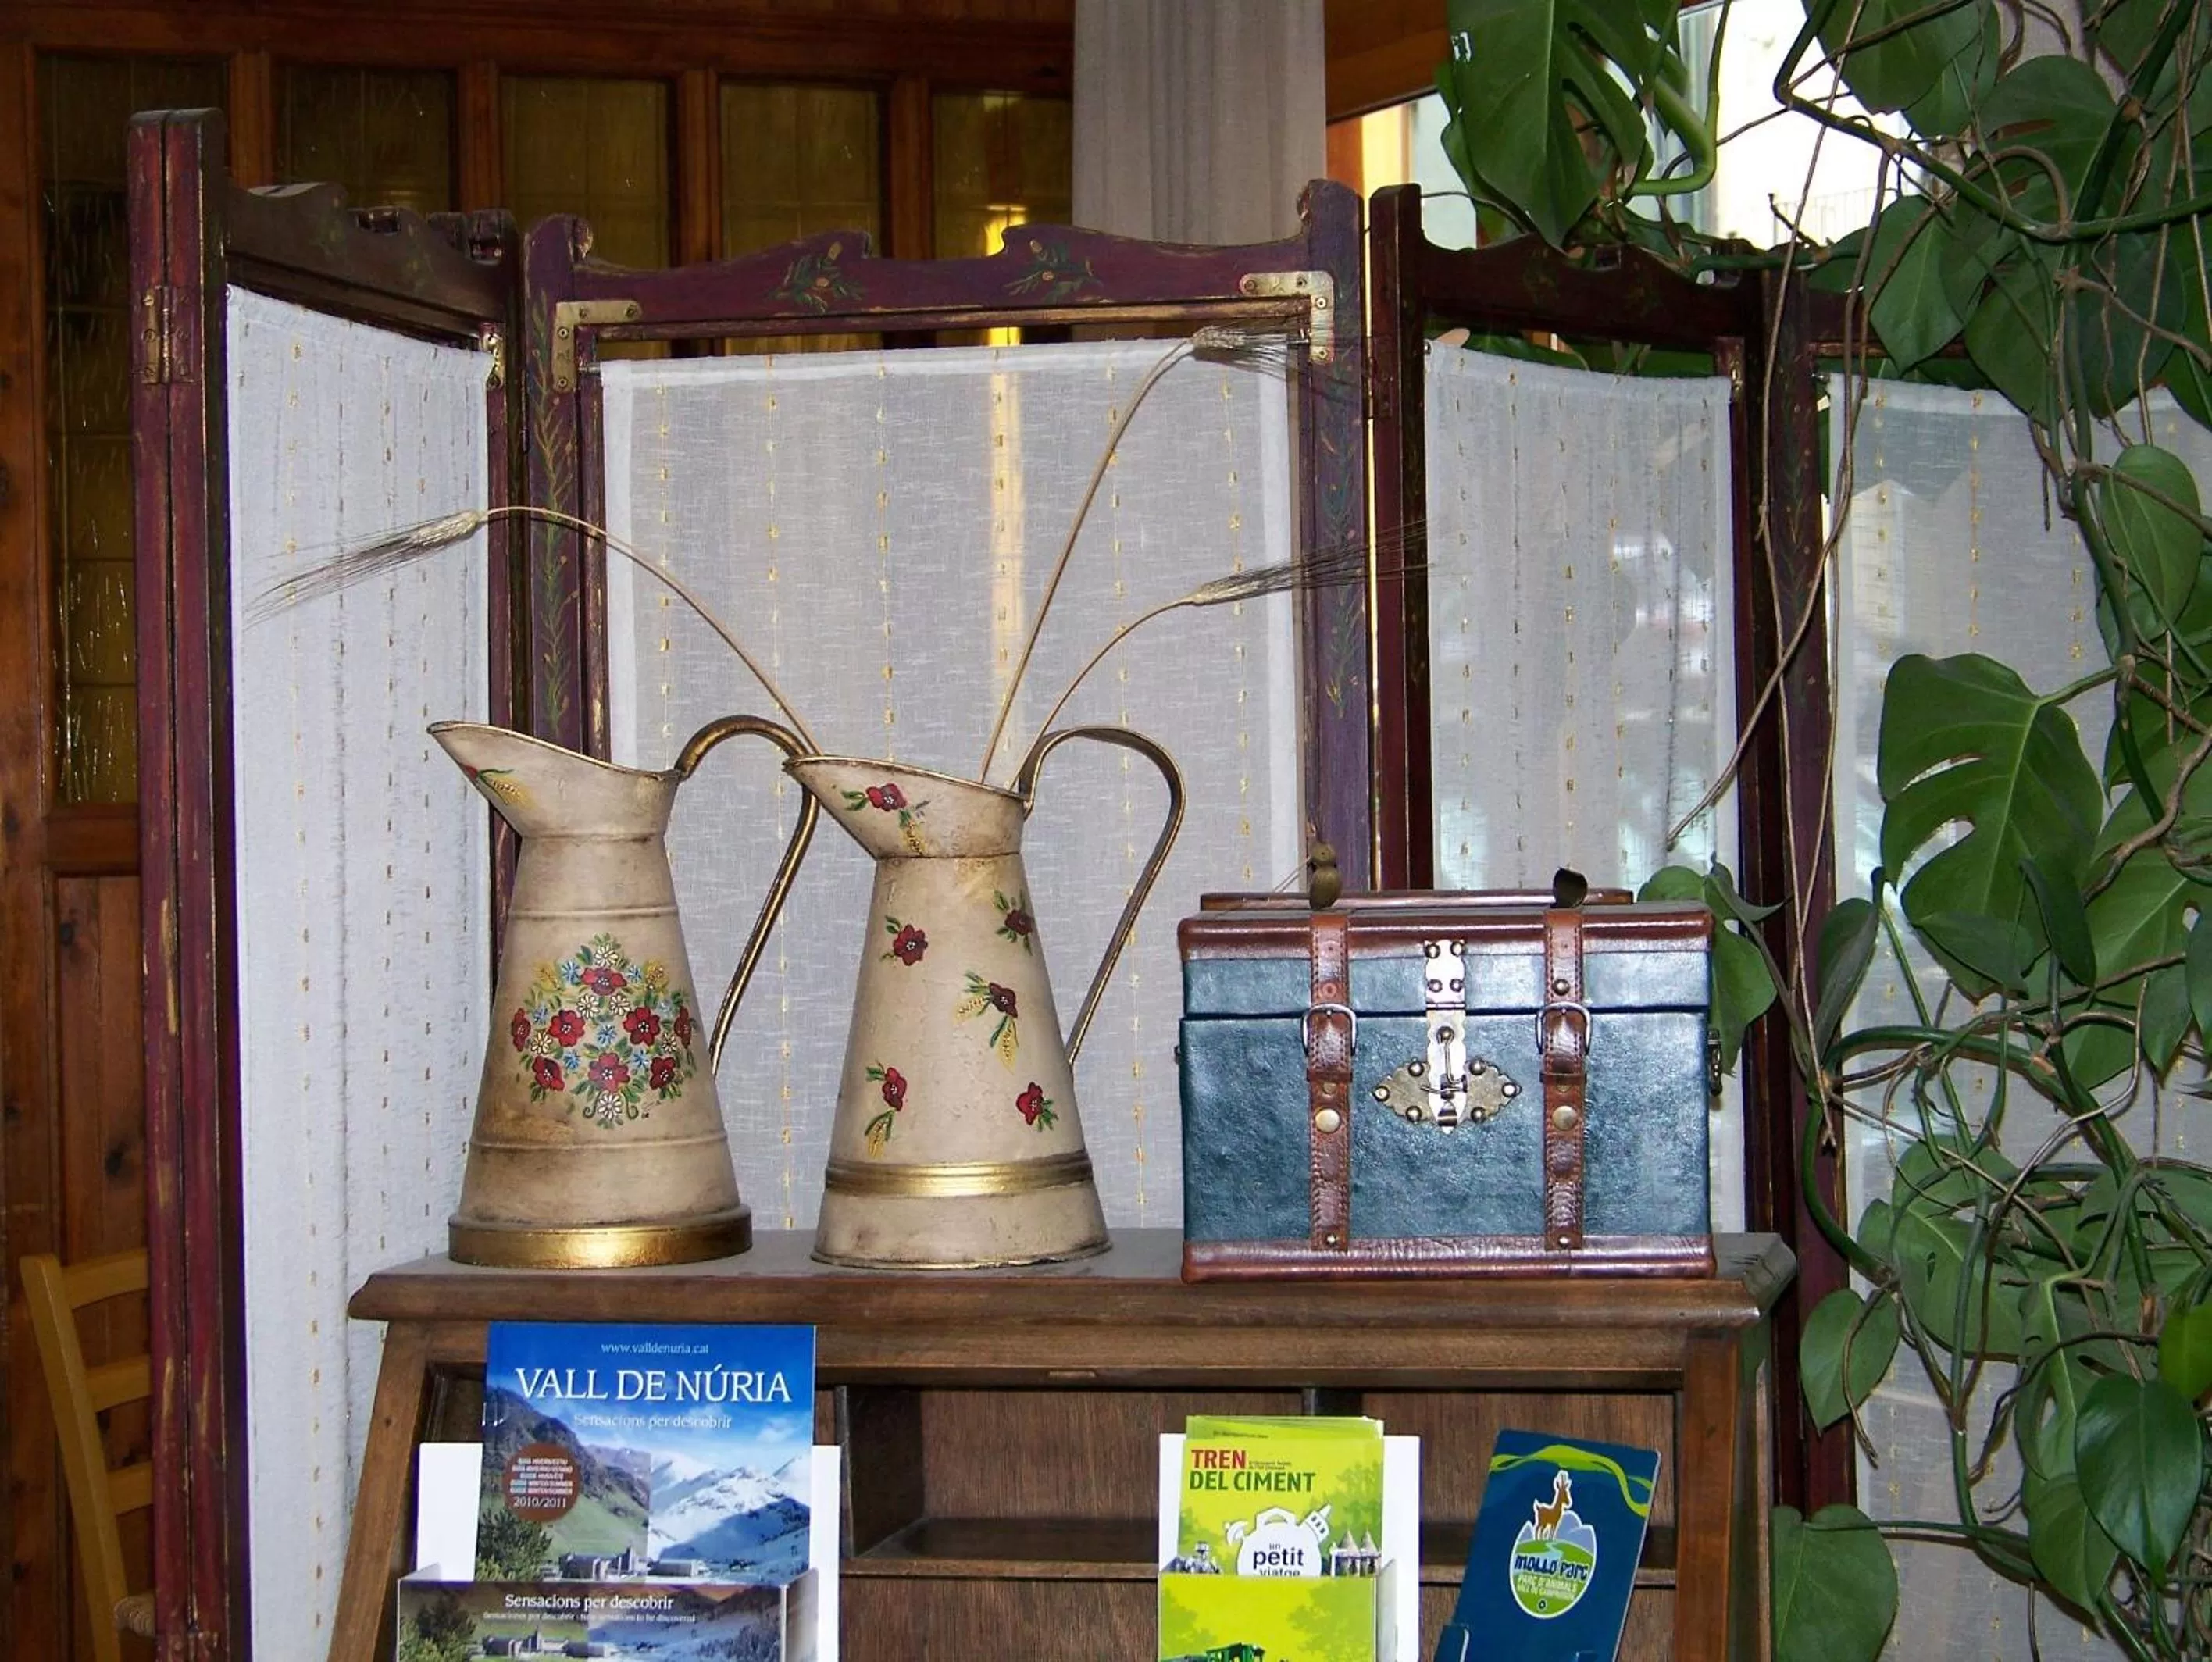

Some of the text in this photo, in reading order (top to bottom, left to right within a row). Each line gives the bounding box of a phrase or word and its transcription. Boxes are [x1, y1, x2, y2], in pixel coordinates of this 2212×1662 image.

[601, 1342, 709, 1355] www.valldenuria.cat
[515, 1364, 793, 1403] VALL DE NÚRIA
[573, 1414, 732, 1430] Sensacions per descobrir
[1191, 1449, 1247, 1469] TREN
[1190, 1470, 1316, 1493] DEL CIMENT
[513, 1496, 567, 1509] 2010/2011
[1253, 1546, 1304, 1570] petit
[505, 1594, 674, 1612] Sensacions per descobrir
